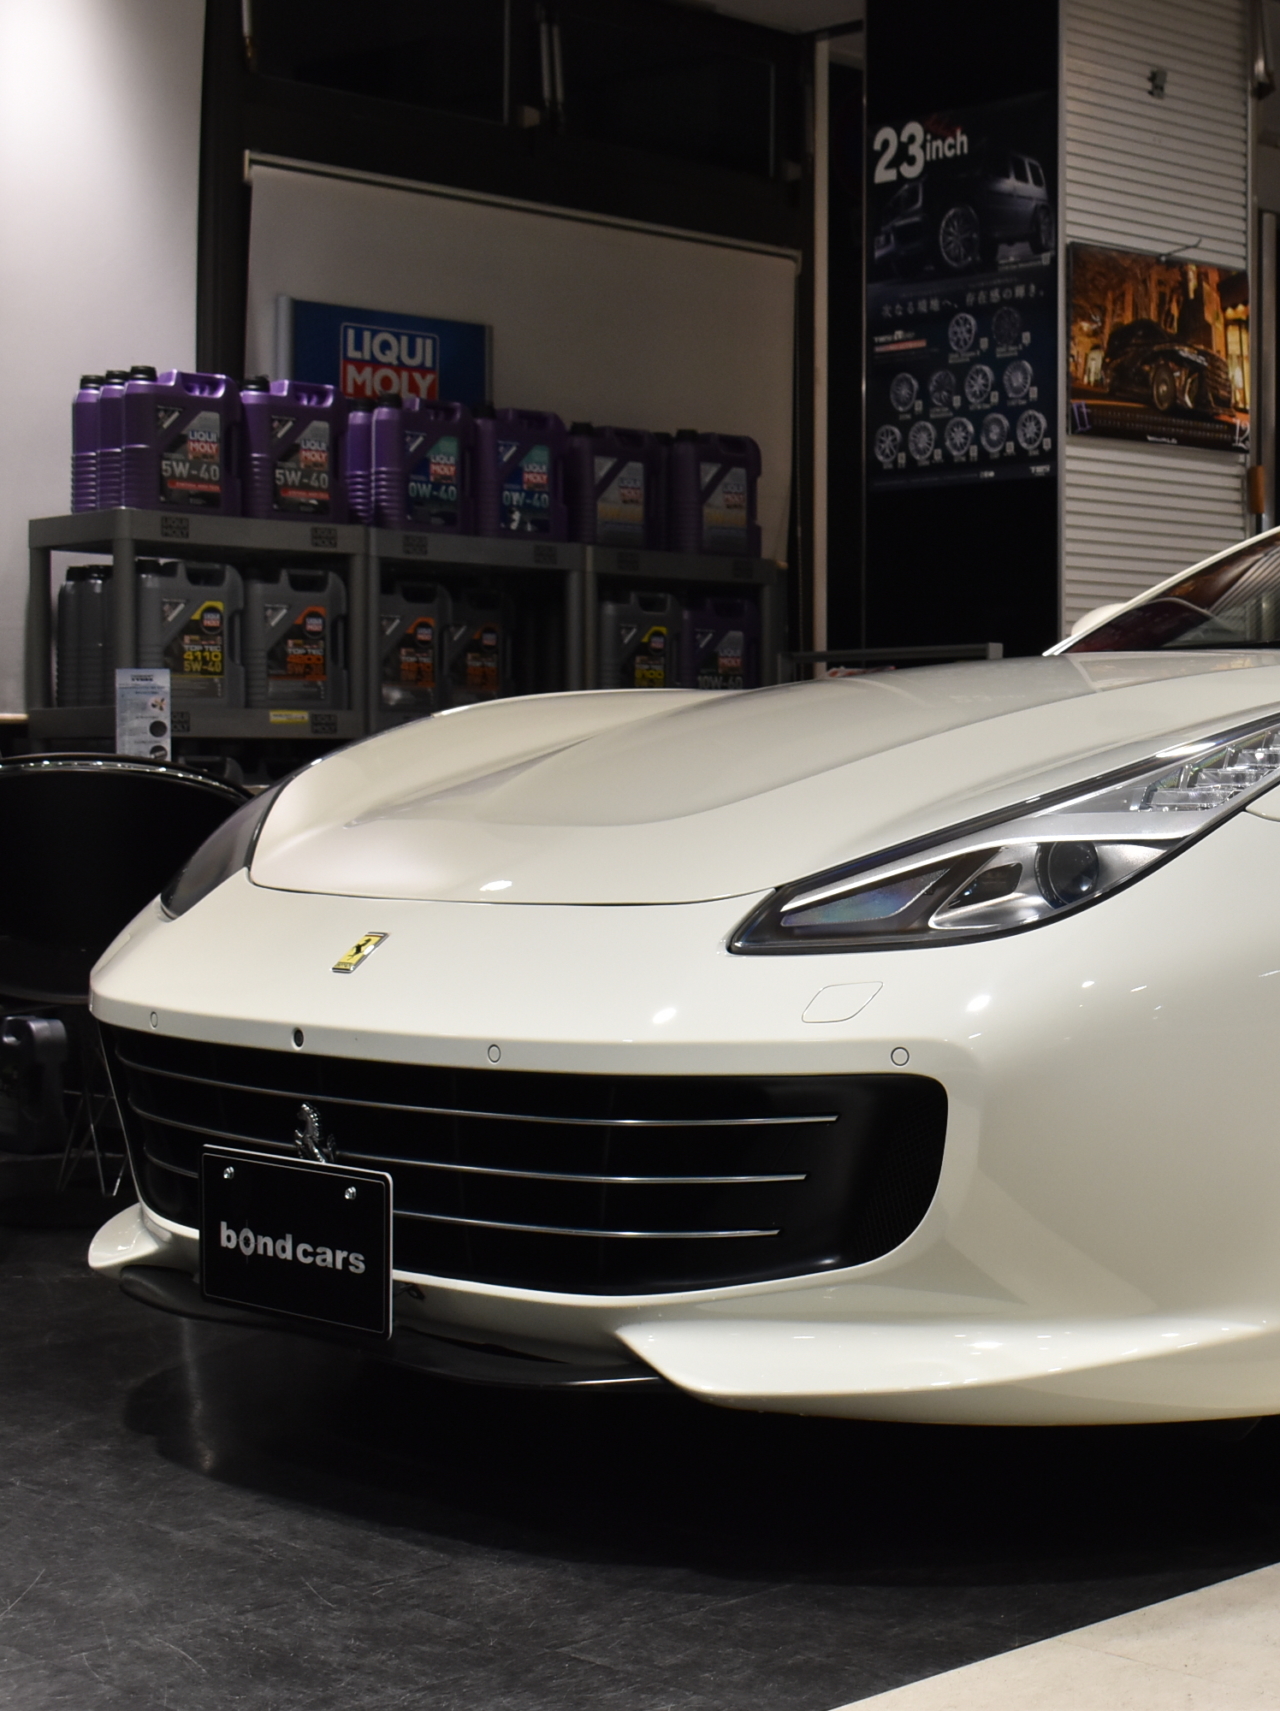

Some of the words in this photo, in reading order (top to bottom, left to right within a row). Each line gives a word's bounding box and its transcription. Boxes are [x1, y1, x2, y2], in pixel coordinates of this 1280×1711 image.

[346, 327, 434, 367] LIQUI
[346, 363, 435, 400] MOLY
[189, 430, 217, 442] LIQUI
[189, 441, 218, 453] MOLY
[301, 440, 328, 451] LIQUI
[301, 450, 328, 461] MOLY
[161, 460, 220, 482] 5W-40
[430, 464, 457, 475] MOLY
[275, 469, 329, 489] 5W-40
[408, 482, 458, 501] 0W-40
[502, 490, 549, 509] 0W-40
[183, 651, 222, 661] 4110
[184, 661, 222, 672] 5W-40
